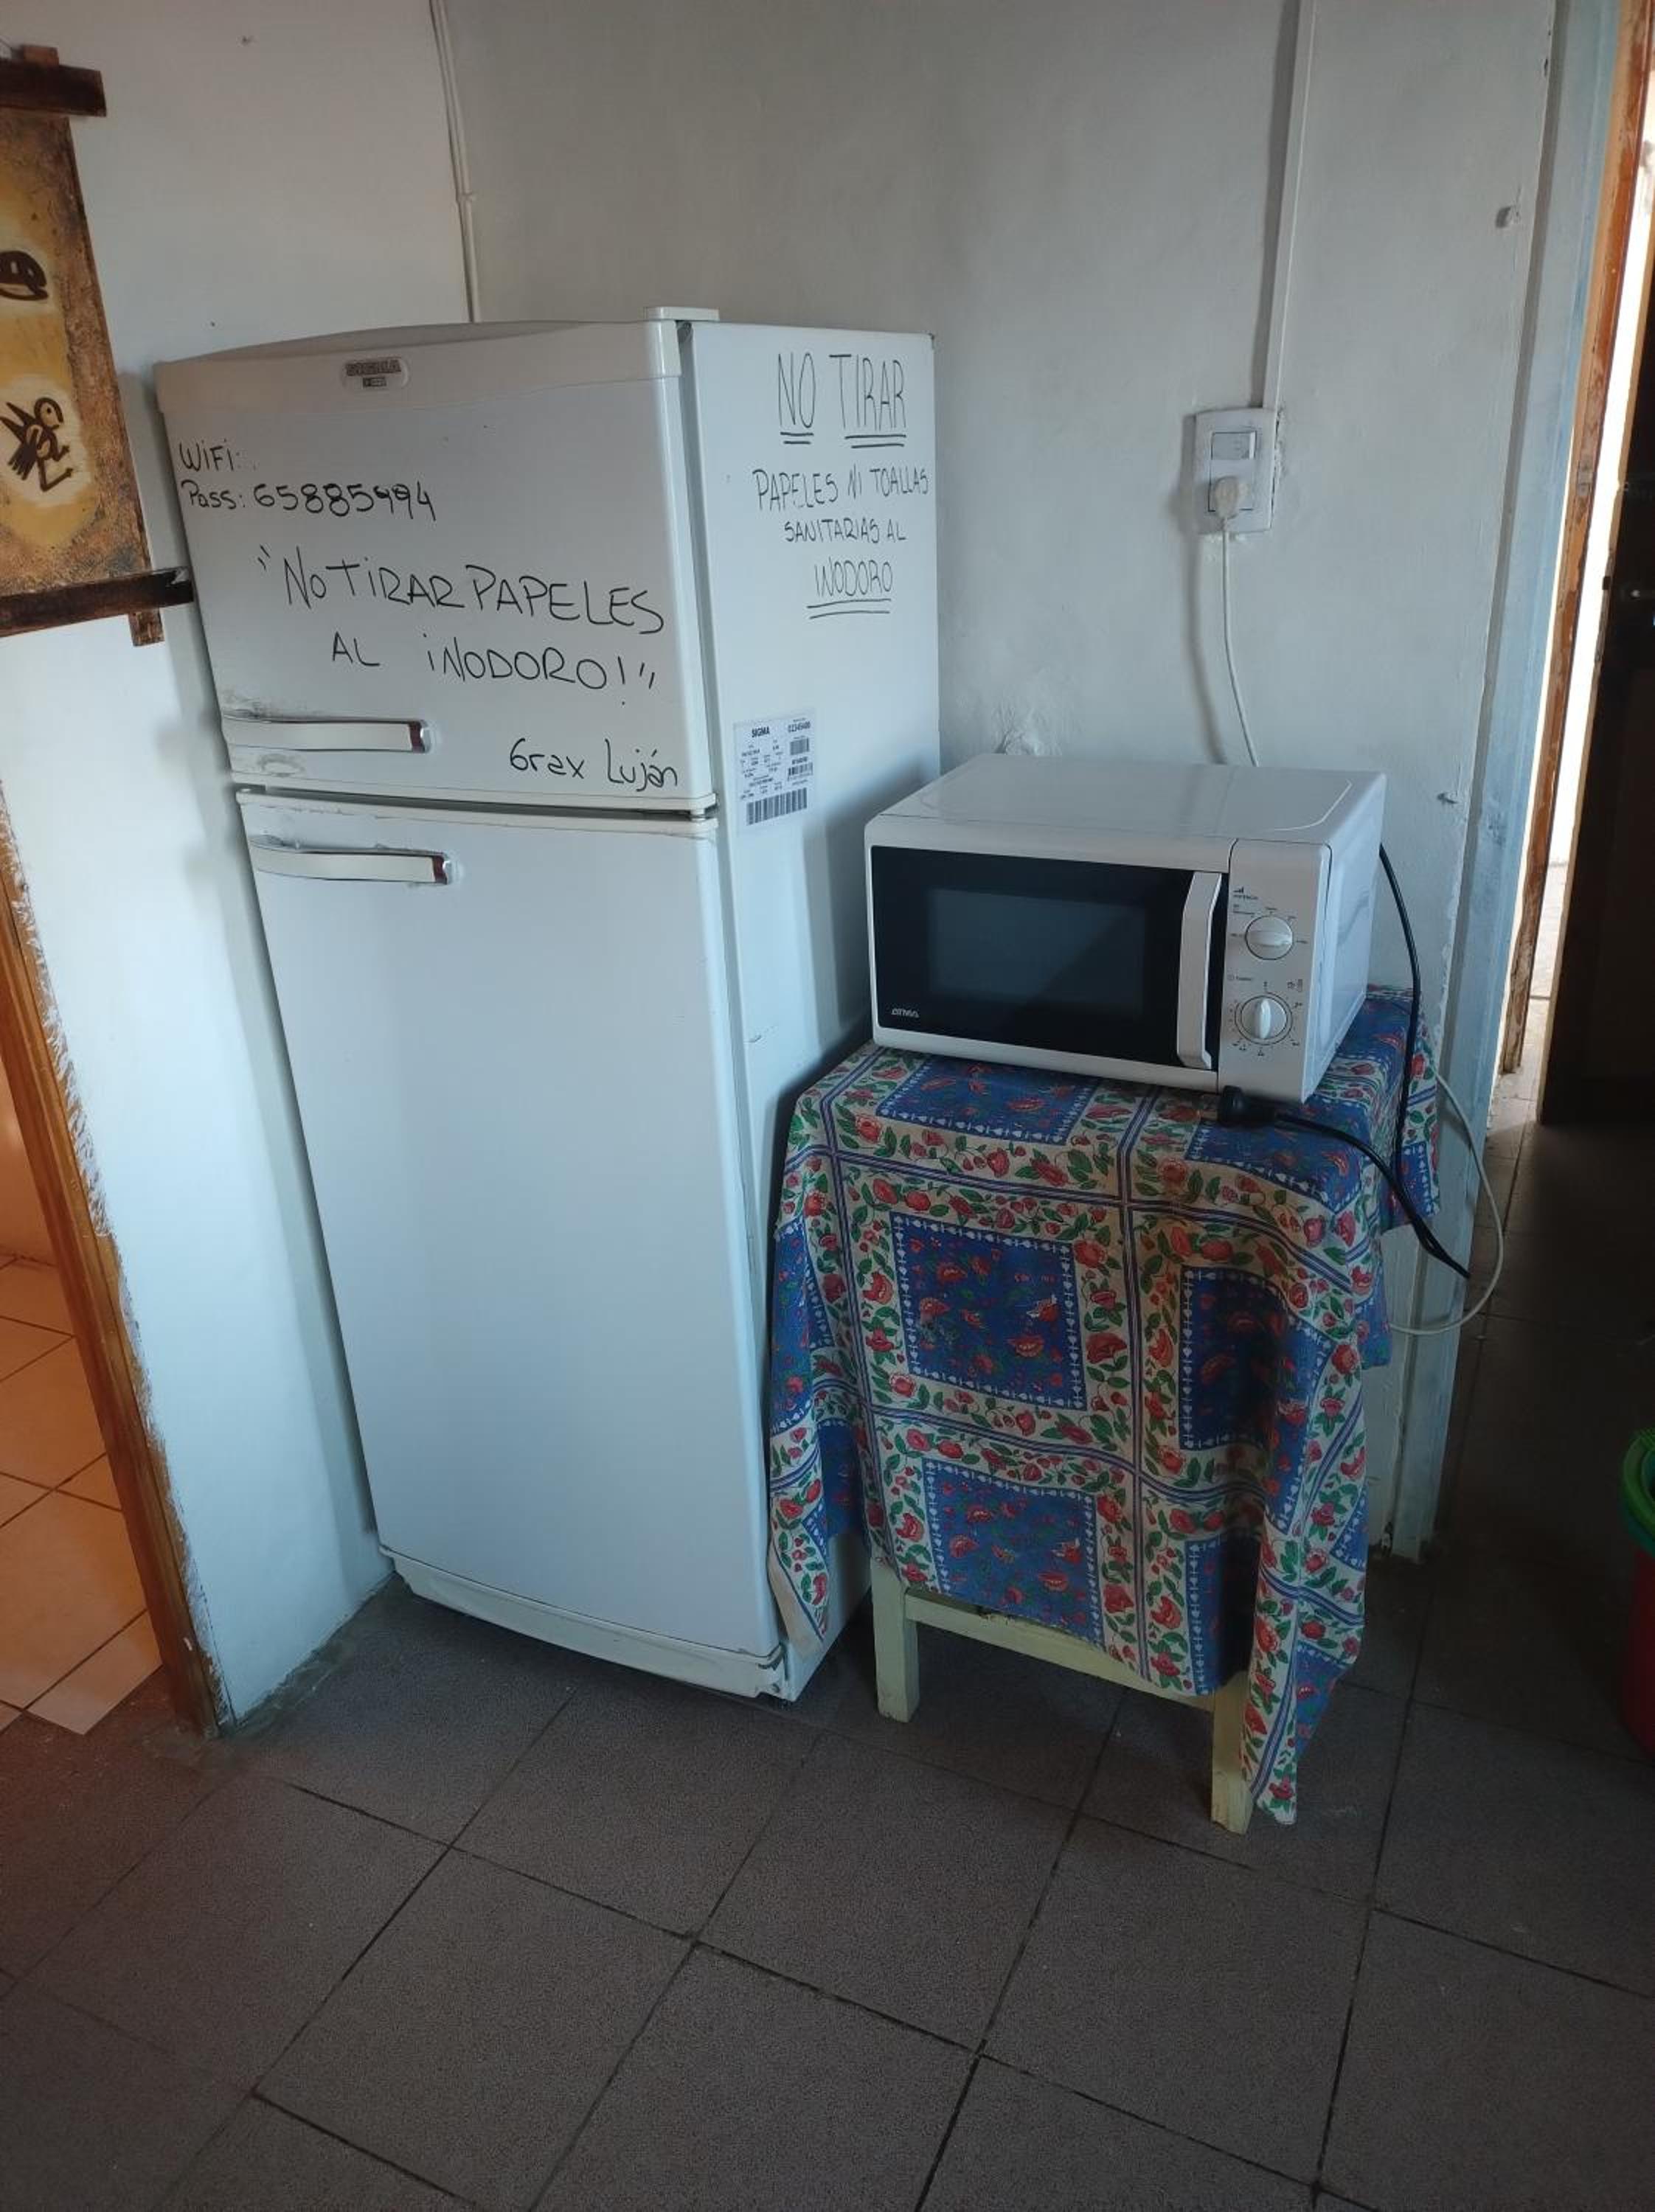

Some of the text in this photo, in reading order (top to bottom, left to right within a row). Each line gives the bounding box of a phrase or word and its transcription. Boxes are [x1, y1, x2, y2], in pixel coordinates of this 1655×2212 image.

[777, 352, 906, 431] NO TIRAR
[752, 468, 839, 511] PAPELES
[869, 467, 929, 497] TOALLAS
[784, 518, 907, 543] SANITARIAS AL
[814, 557, 893, 597] INODORO
[465, 564, 665, 634] PAPELES
[331, 631, 381, 667] AL
